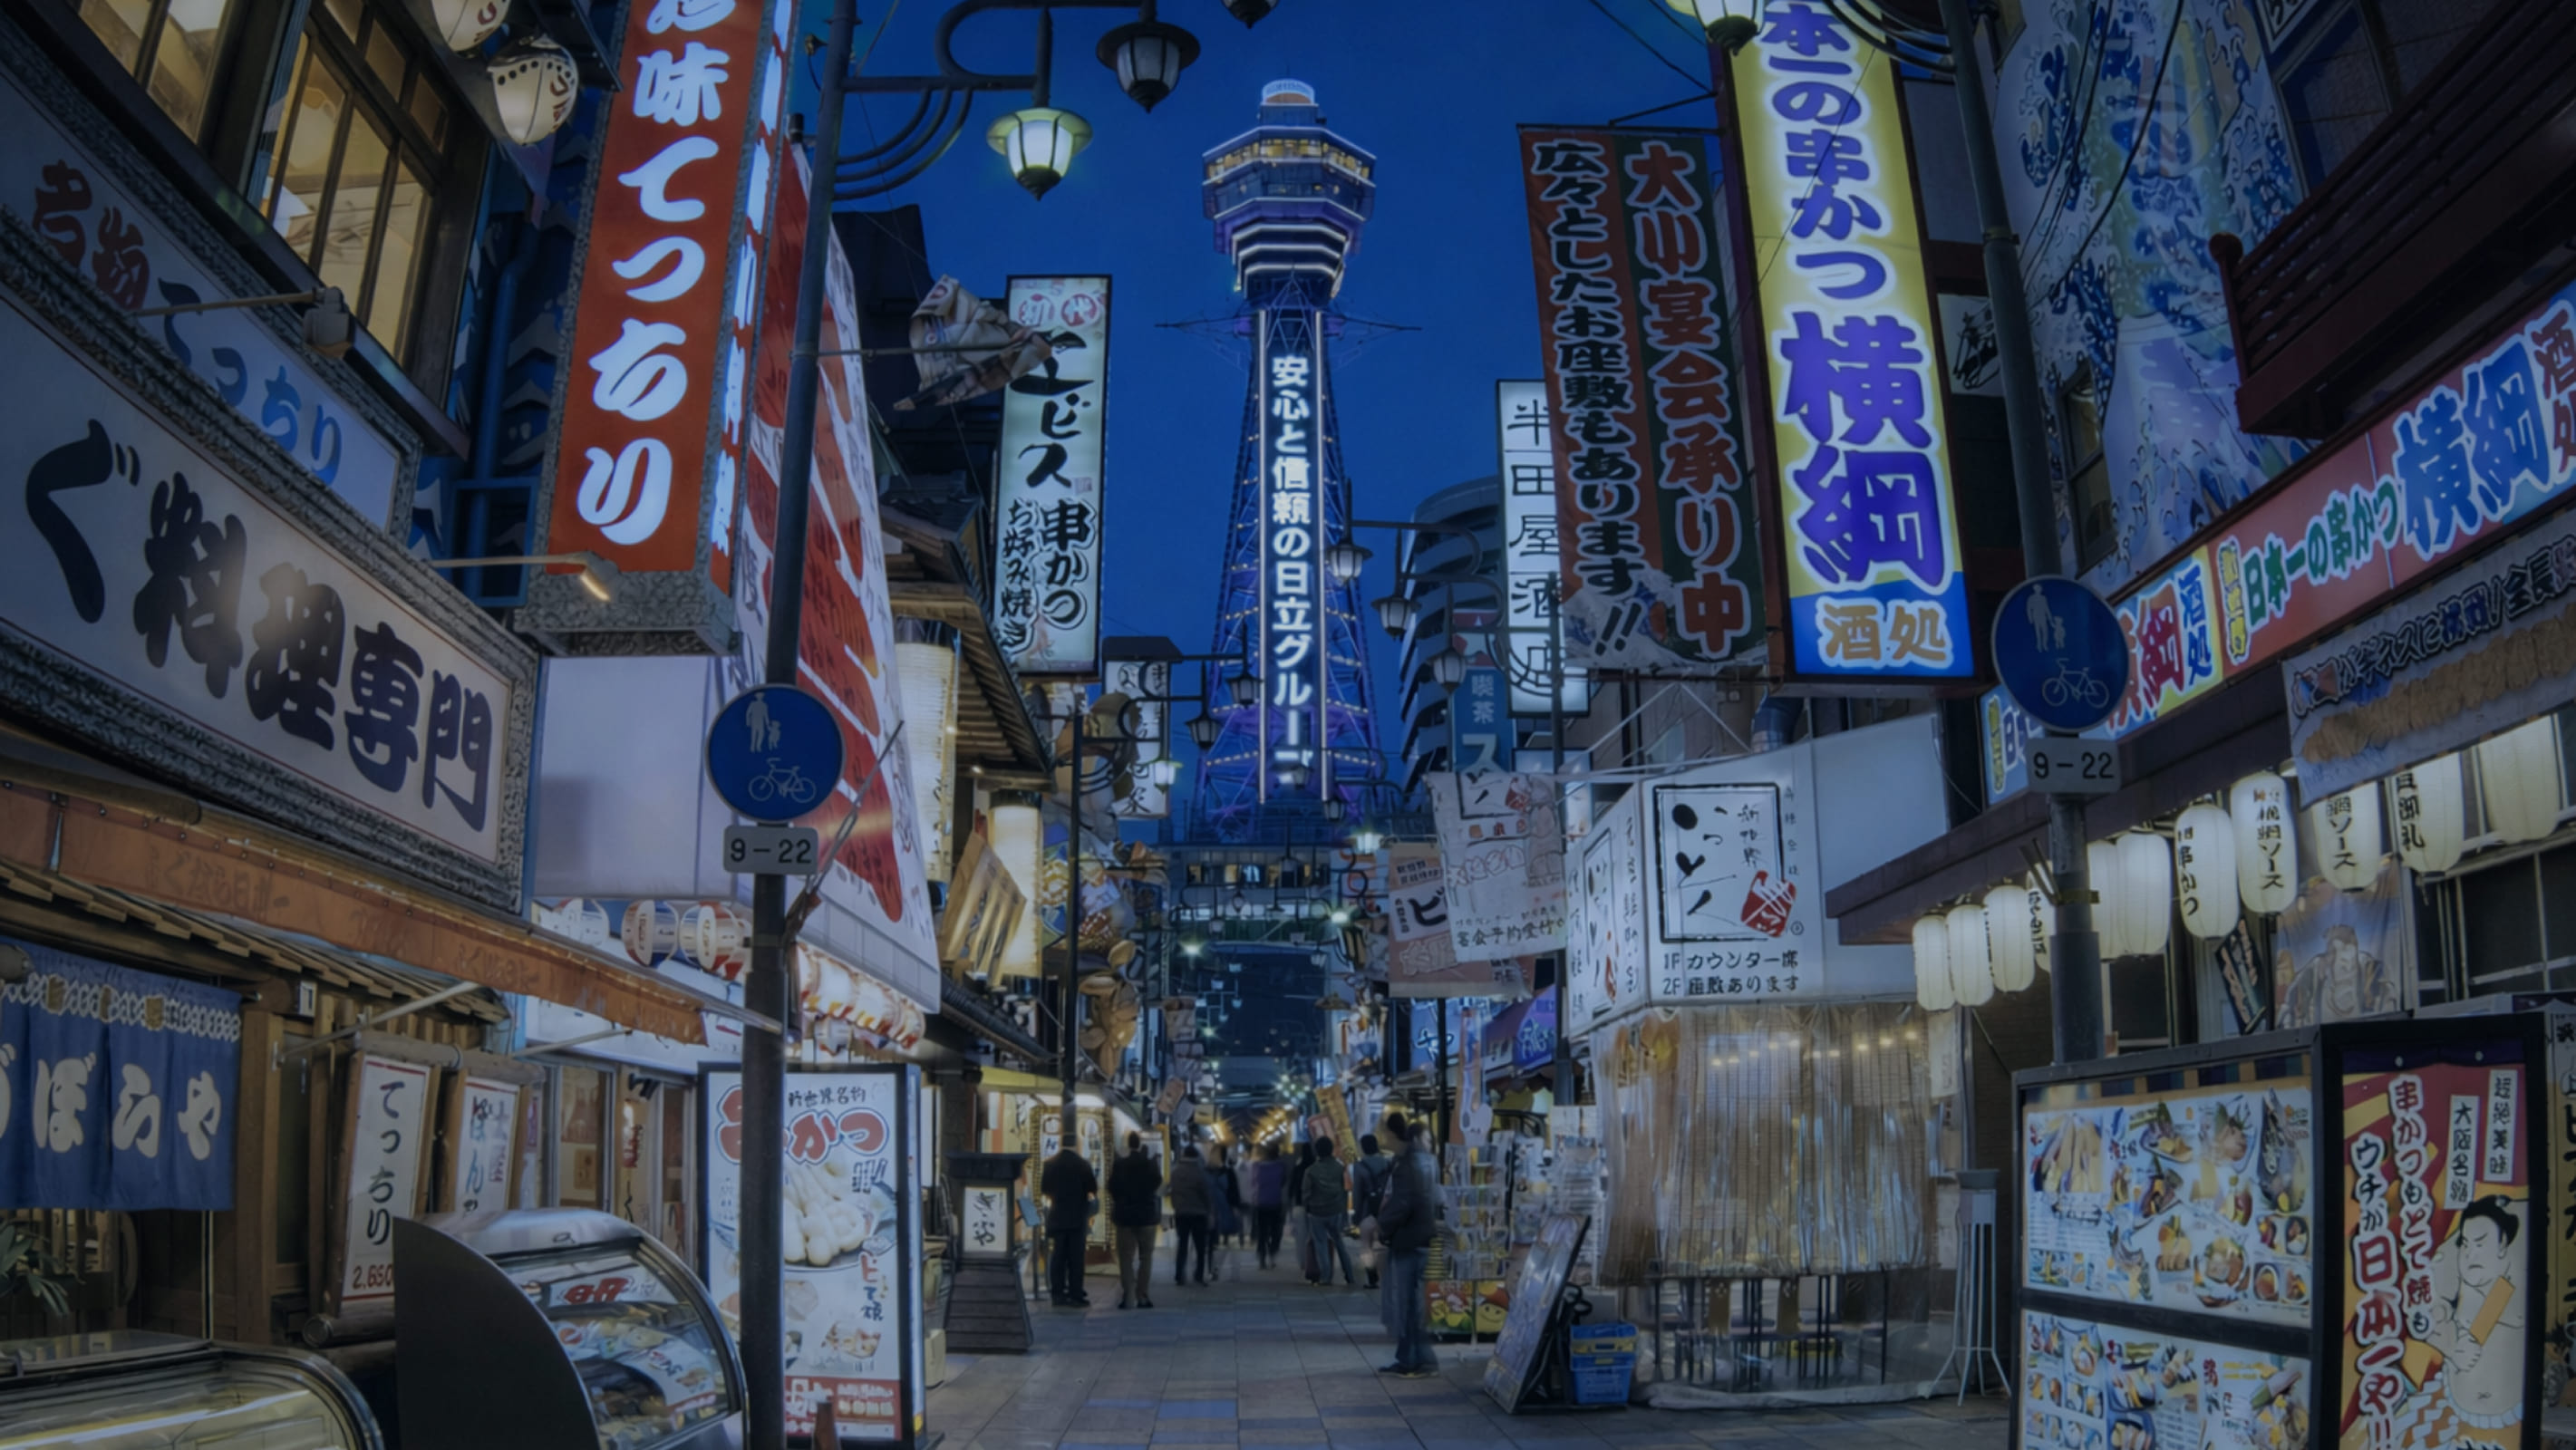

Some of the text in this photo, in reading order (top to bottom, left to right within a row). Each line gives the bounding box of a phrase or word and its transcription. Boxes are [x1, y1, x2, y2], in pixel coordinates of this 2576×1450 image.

[1780, 311, 1946, 587] 横綱
[1000, 498, 1035, 649] お好み焼き
[1041, 498, 1090, 624] 串かつ
[25, 419, 493, 832] ぐ料理専門
[1821, 600, 1949, 663] 酒処
[2033, 751, 2115, 778] 9-22
[730, 838, 812, 865] 9-22
[1663, 977, 1681, 995] 2F
[1664, 952, 1680, 971] 1F
[367, 1080, 405, 1246] てっちり
